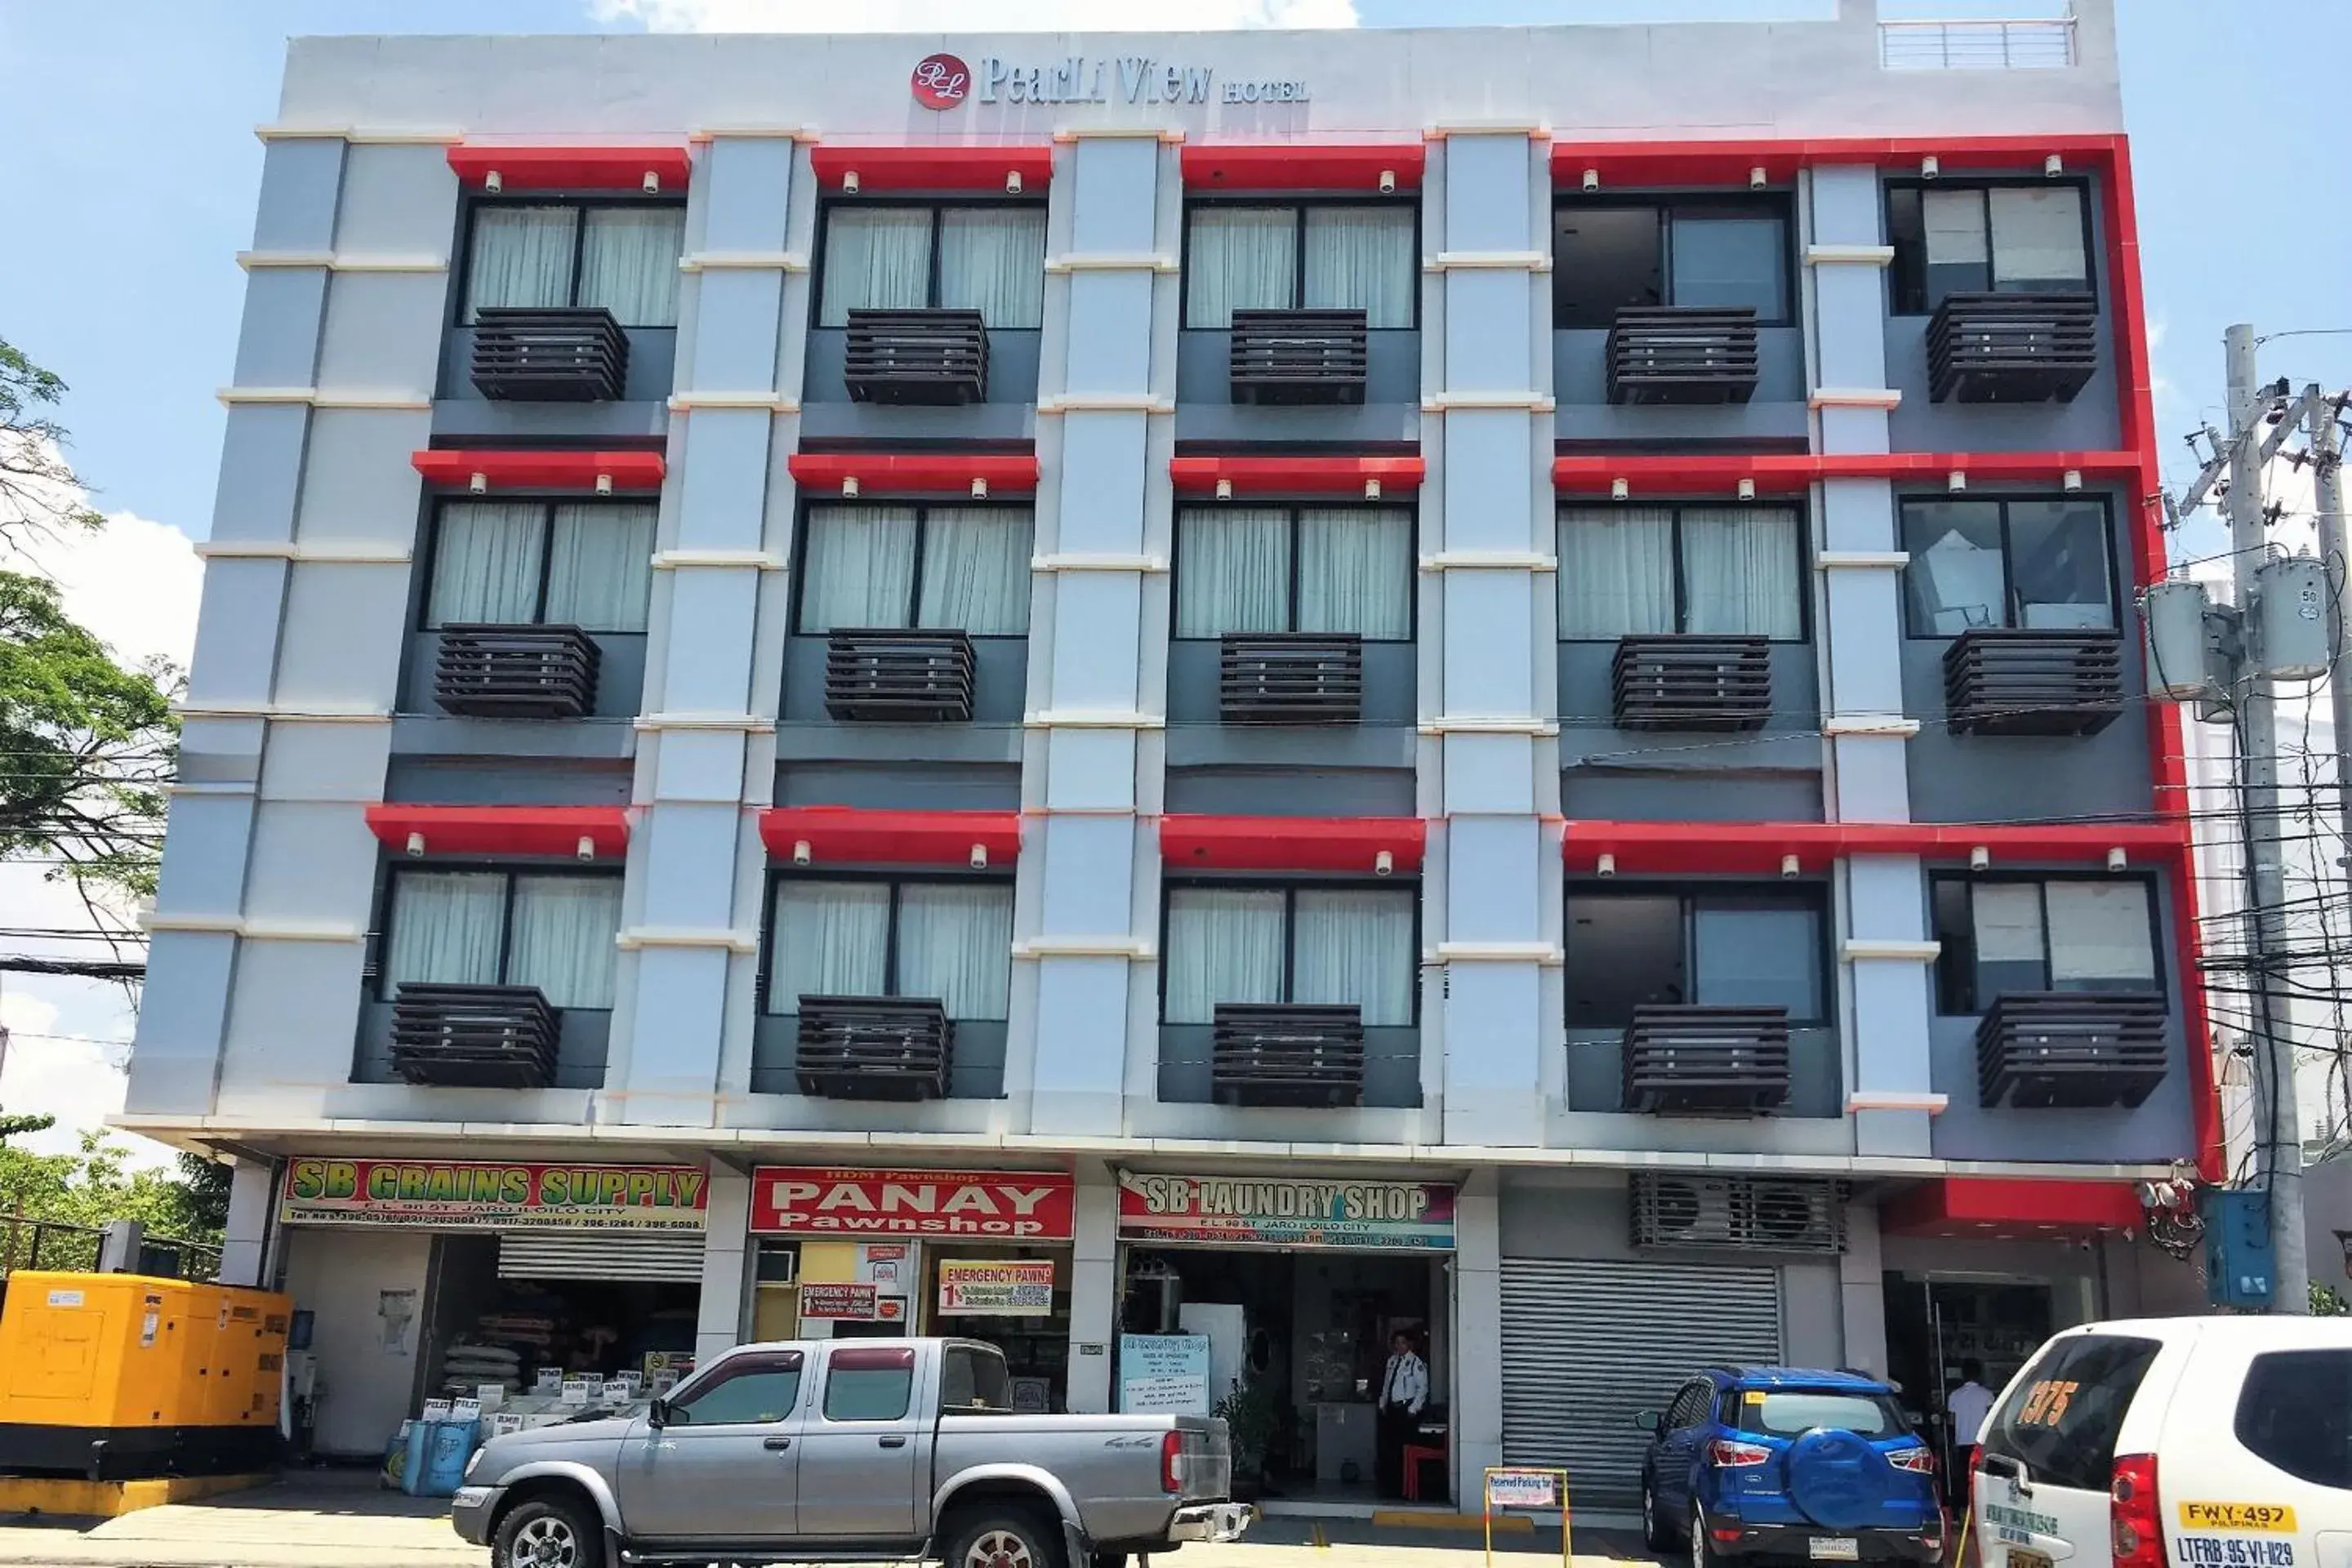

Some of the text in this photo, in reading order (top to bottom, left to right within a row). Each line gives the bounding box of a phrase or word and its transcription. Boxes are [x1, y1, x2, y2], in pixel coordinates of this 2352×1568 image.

[1116, 57, 1214, 105] View
[1222, 79, 1310, 105] HOTEL
[2302, 590, 2318, 603] 50
[292, 1160, 706, 1207] SB GRAINS SUPPLY
[772, 1181, 1054, 1216] PANAY
[1146, 1177, 1428, 1220] SB LAUNDRY SHOP
[778, 1212, 1044, 1236] Pawnshop
[1263, 1221, 1297, 1229] JARO
[1299, 1222, 1339, 1230] ILOILO
[1343, 1223, 1370, 1232] CITY
[948, 1268, 1012, 1283] EMERGENCY
[804, 1287, 849, 1297] EMERGENCY
[2210, 1520, 2269, 1529] PILIPINAS
